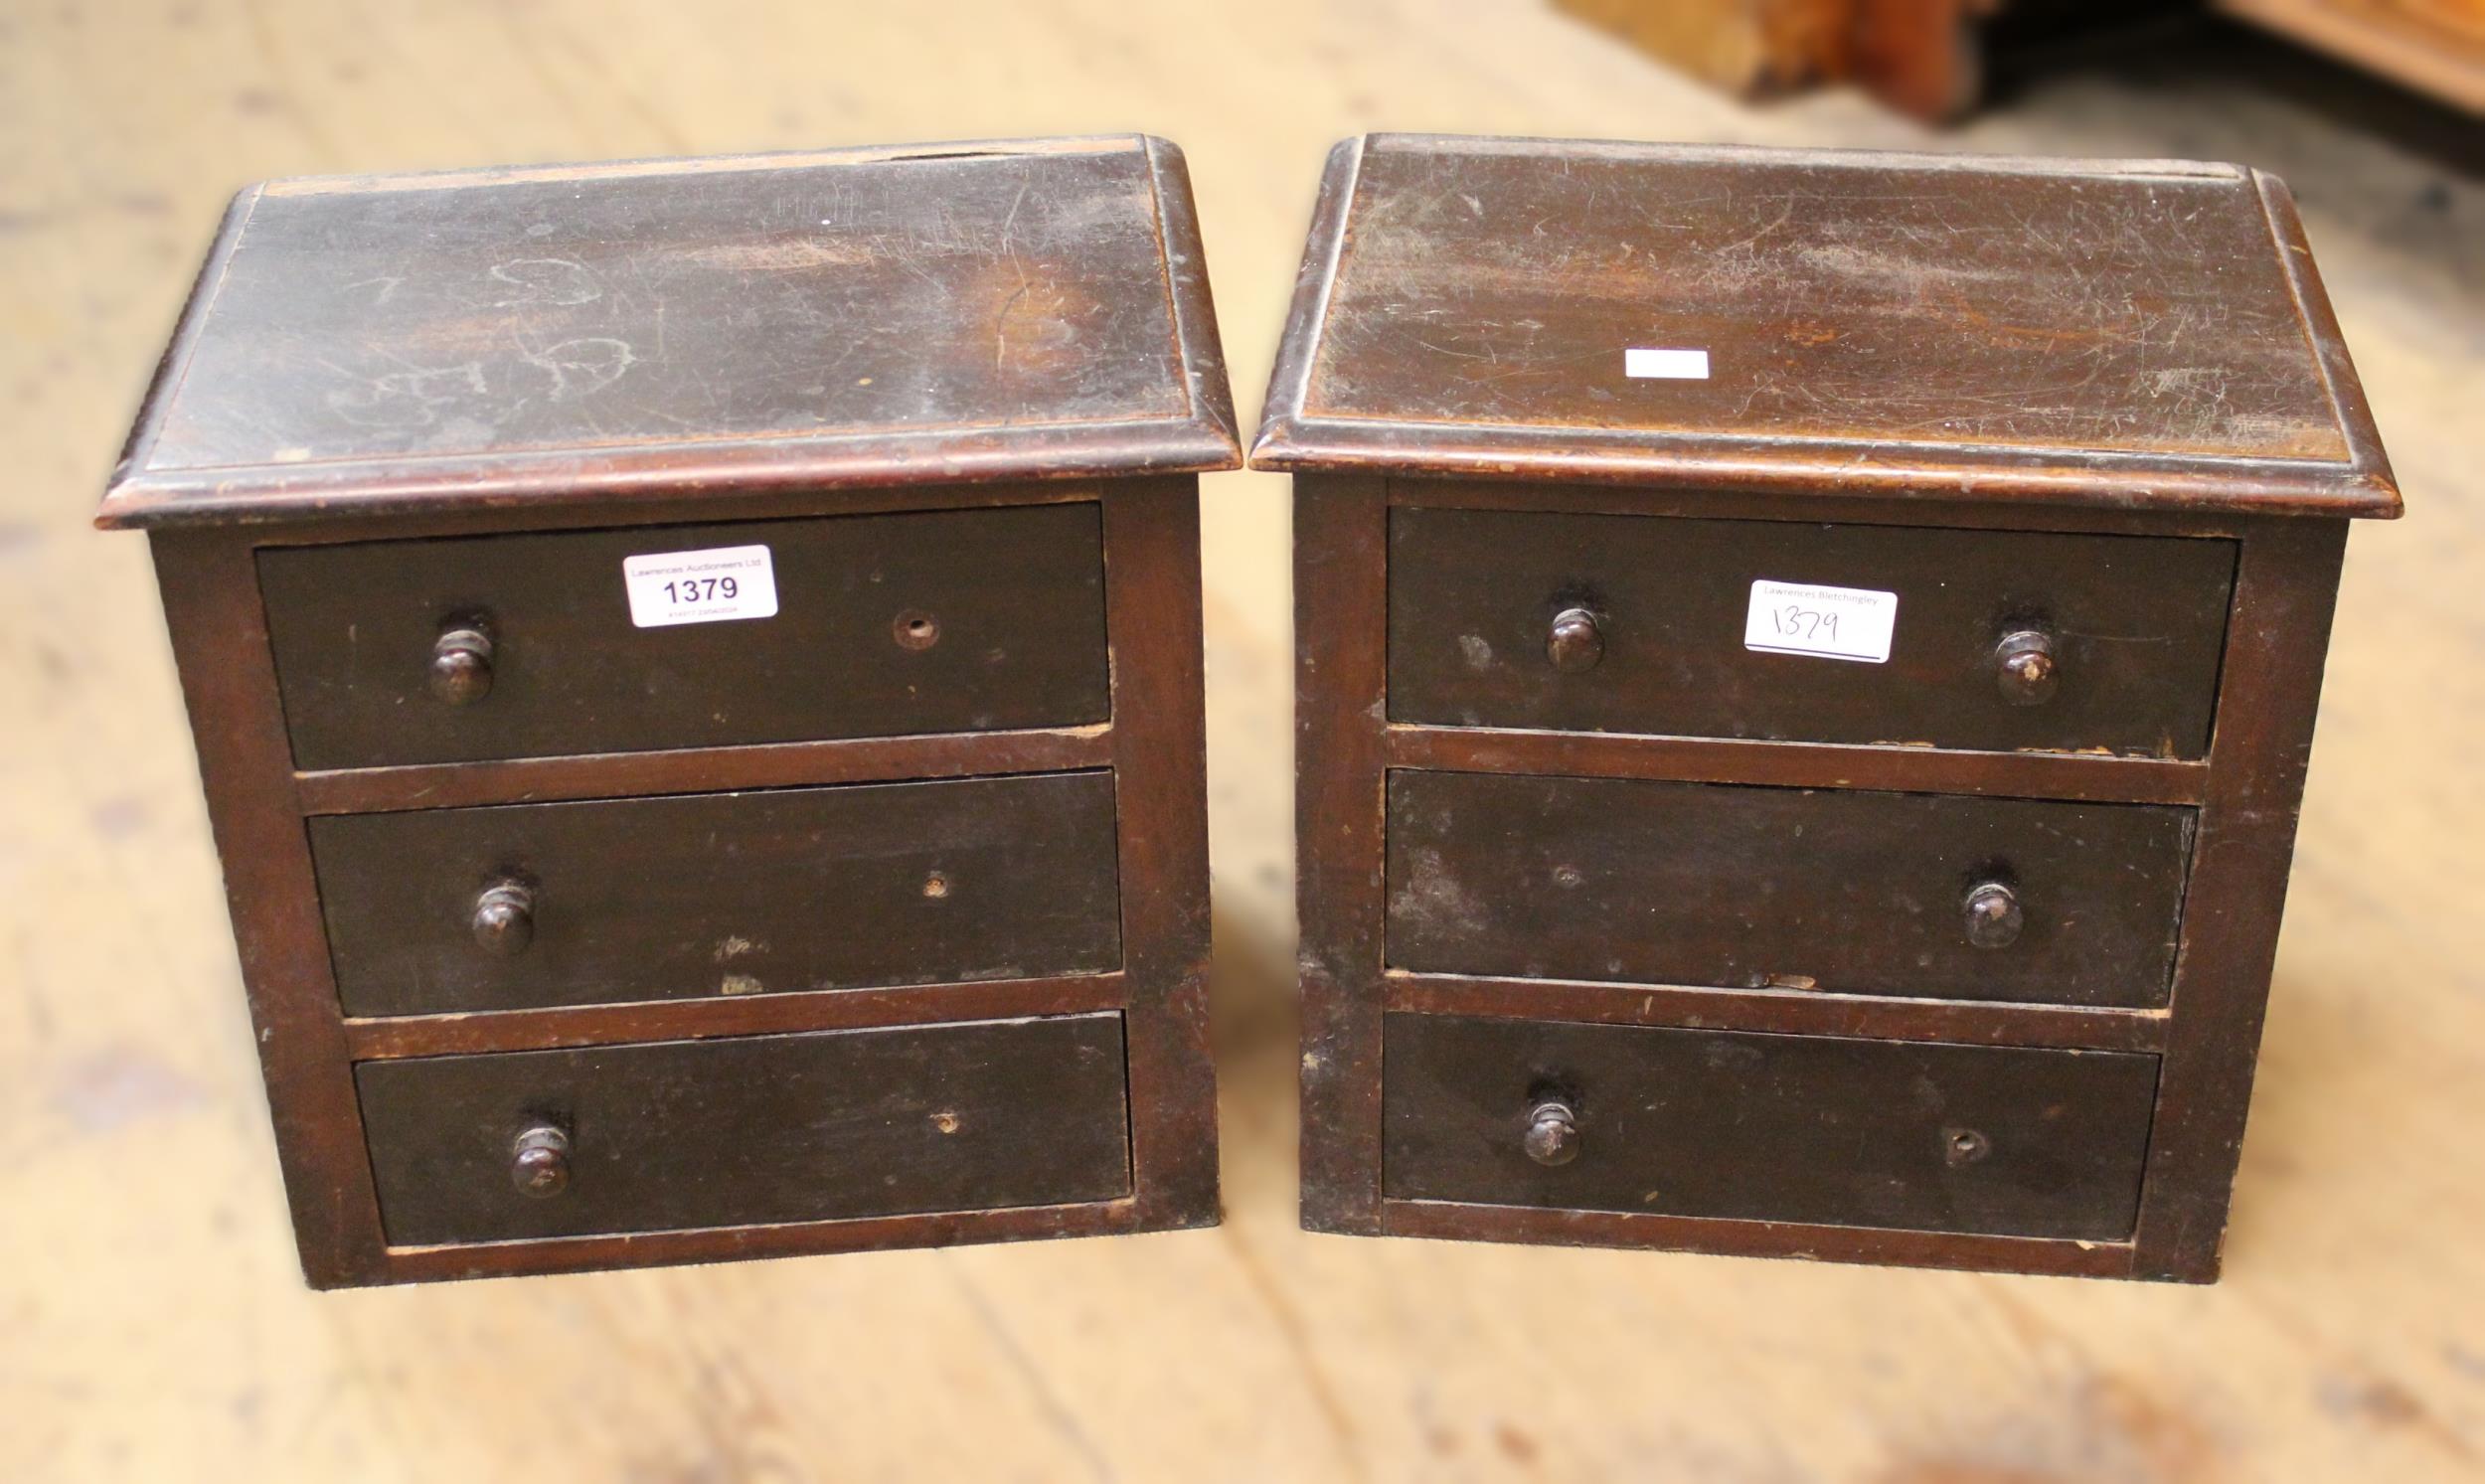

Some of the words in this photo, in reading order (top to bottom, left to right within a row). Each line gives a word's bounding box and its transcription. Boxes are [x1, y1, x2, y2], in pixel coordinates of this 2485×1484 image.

[631, 567, 683, 577] Lawrences
[687, 561, 744, 573] Auctioneers
[746, 559, 761, 569] Ltd
[664, 577, 739, 603] 1379
[1764, 585, 1816, 598] Lawrences
[1818, 590, 1879, 606] Bletchingley
[1773, 604, 1838, 642] 1379
